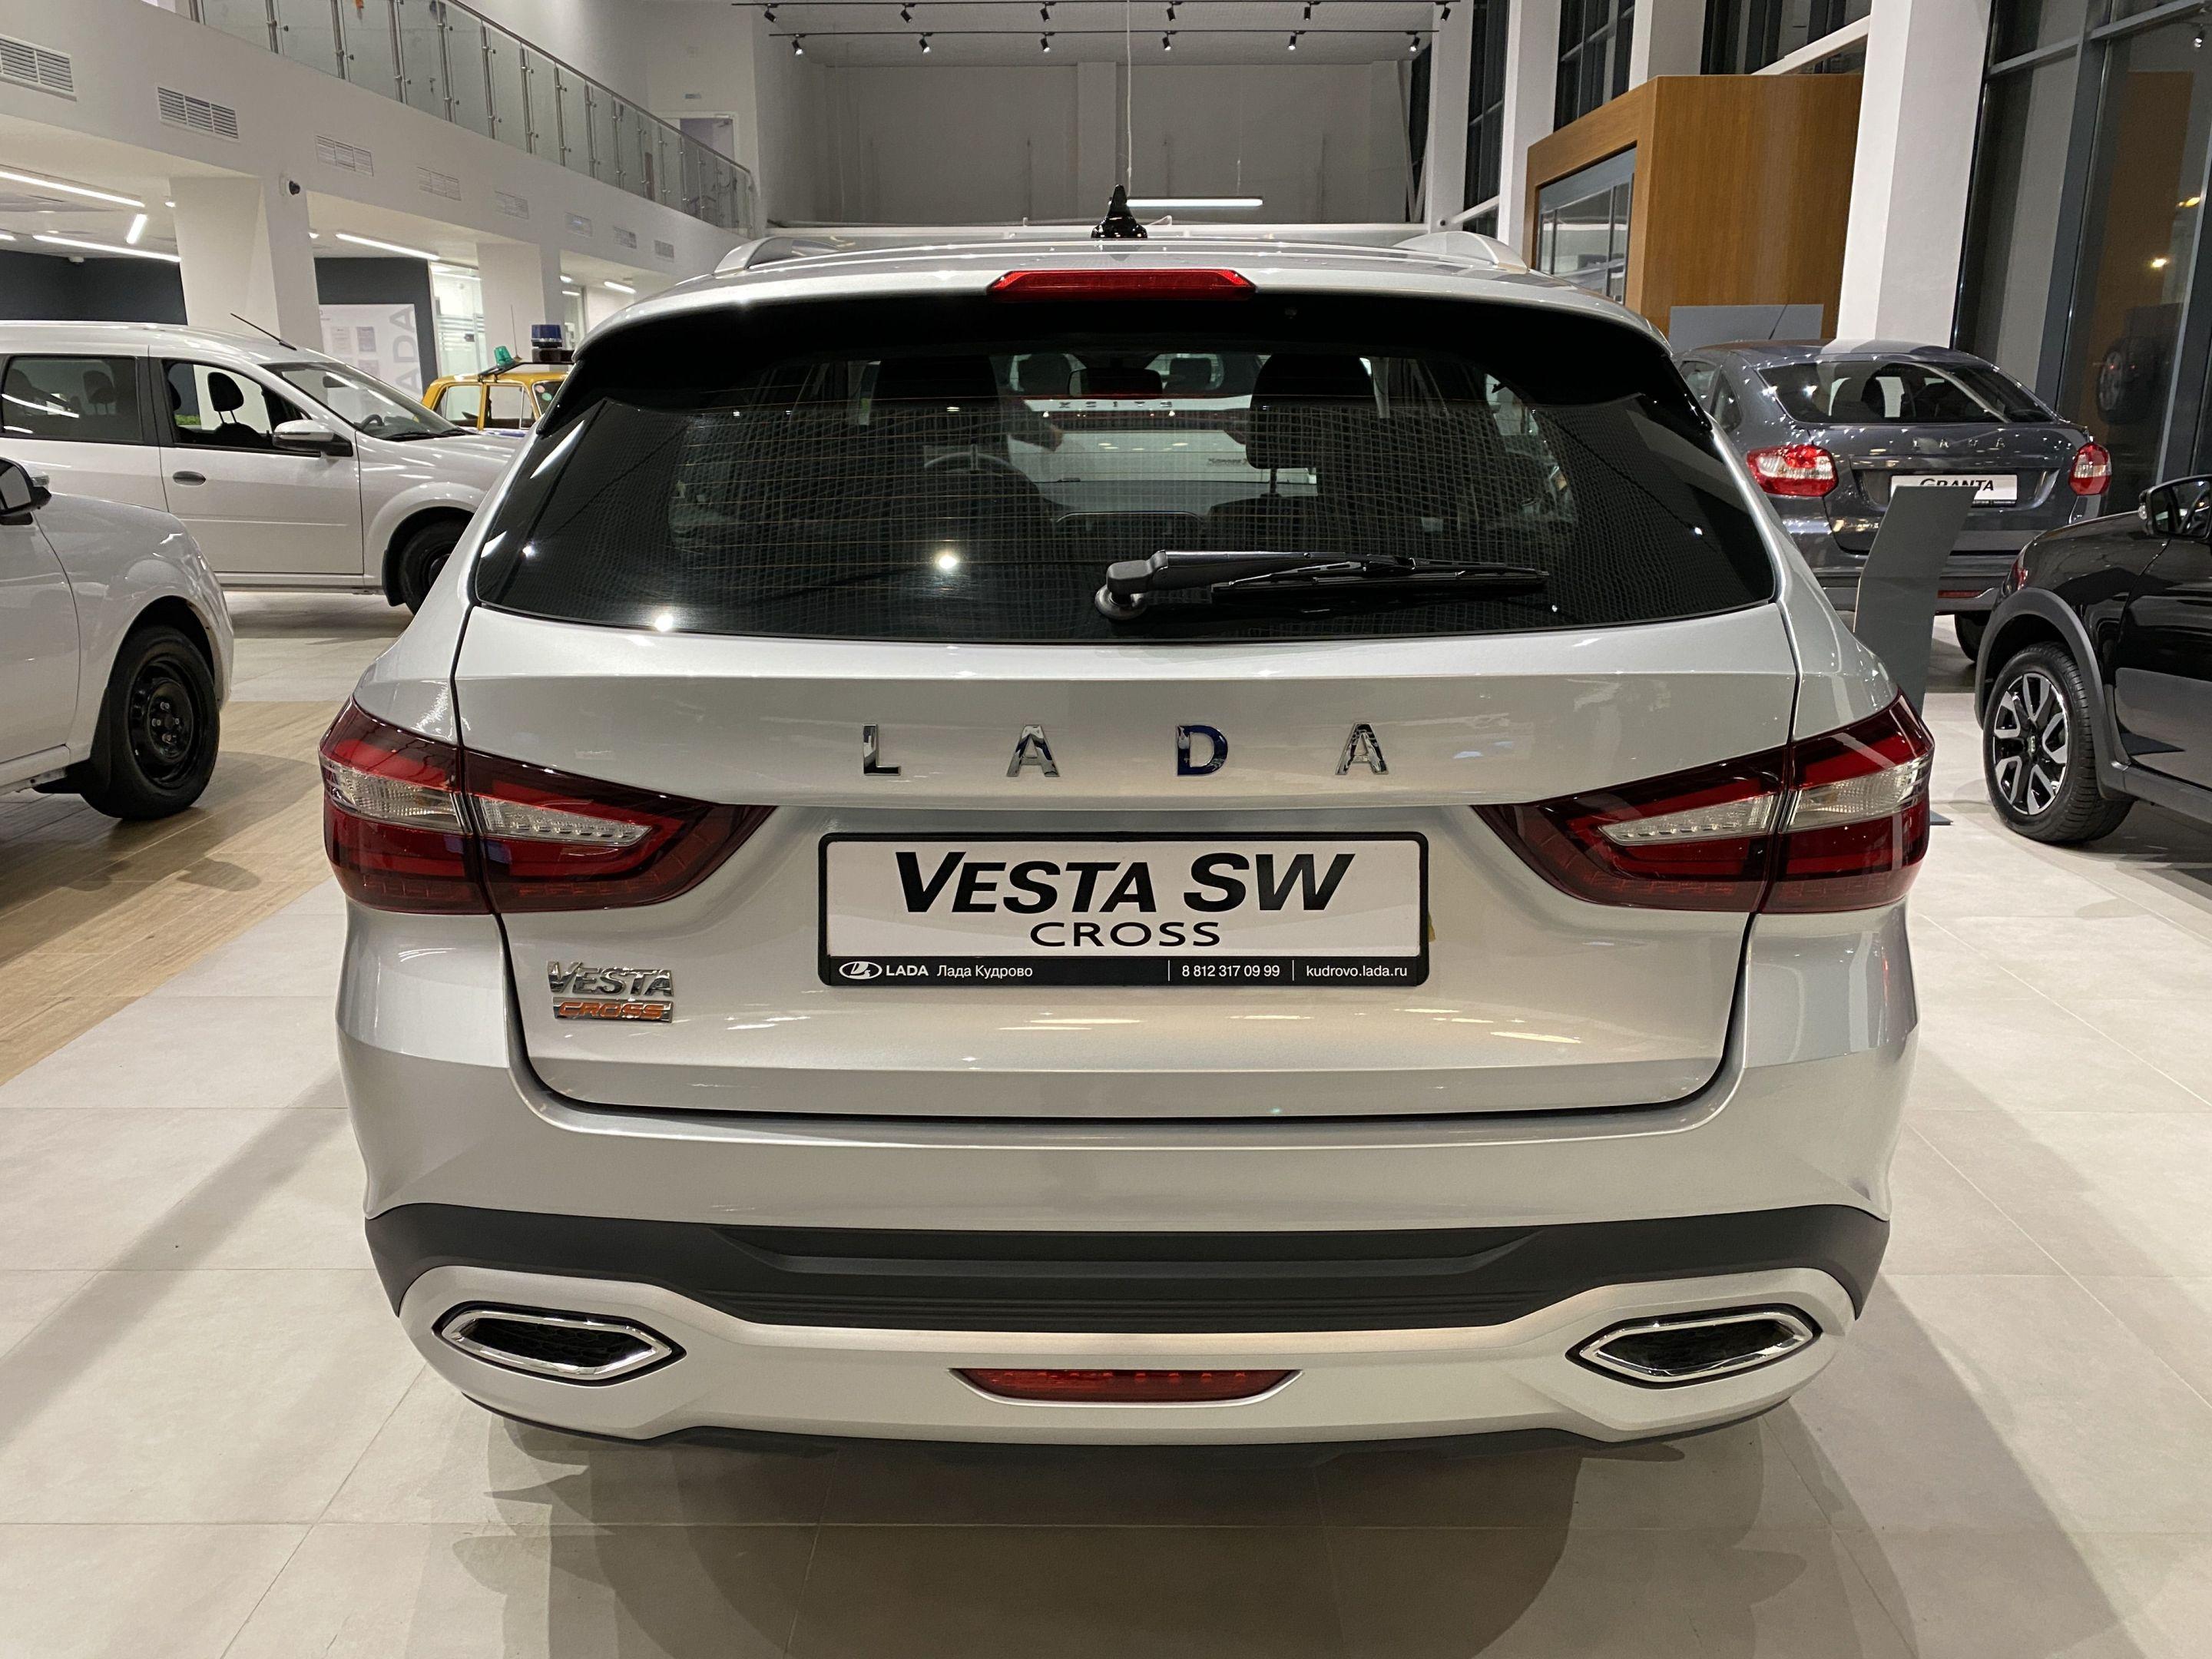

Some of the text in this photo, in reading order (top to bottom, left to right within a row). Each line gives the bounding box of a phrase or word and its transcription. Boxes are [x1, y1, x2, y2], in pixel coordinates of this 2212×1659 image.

[389, 306, 422, 396] ADA
[862, 722, 1389, 777] LADA
[895, 850, 1356, 914] VESTA SW
[1029, 922, 1220, 947] CROSS
[547, 960, 674, 996] VESTA
[886, 965, 929, 976] LADA
[936, 965, 1033, 979] Лада Кудрово
[1181, 965, 1280, 977] 8 812 317 09 99
[1306, 964, 1408, 977] kudrovo.lada.ru
[558, 1001, 667, 1018] CROSS
